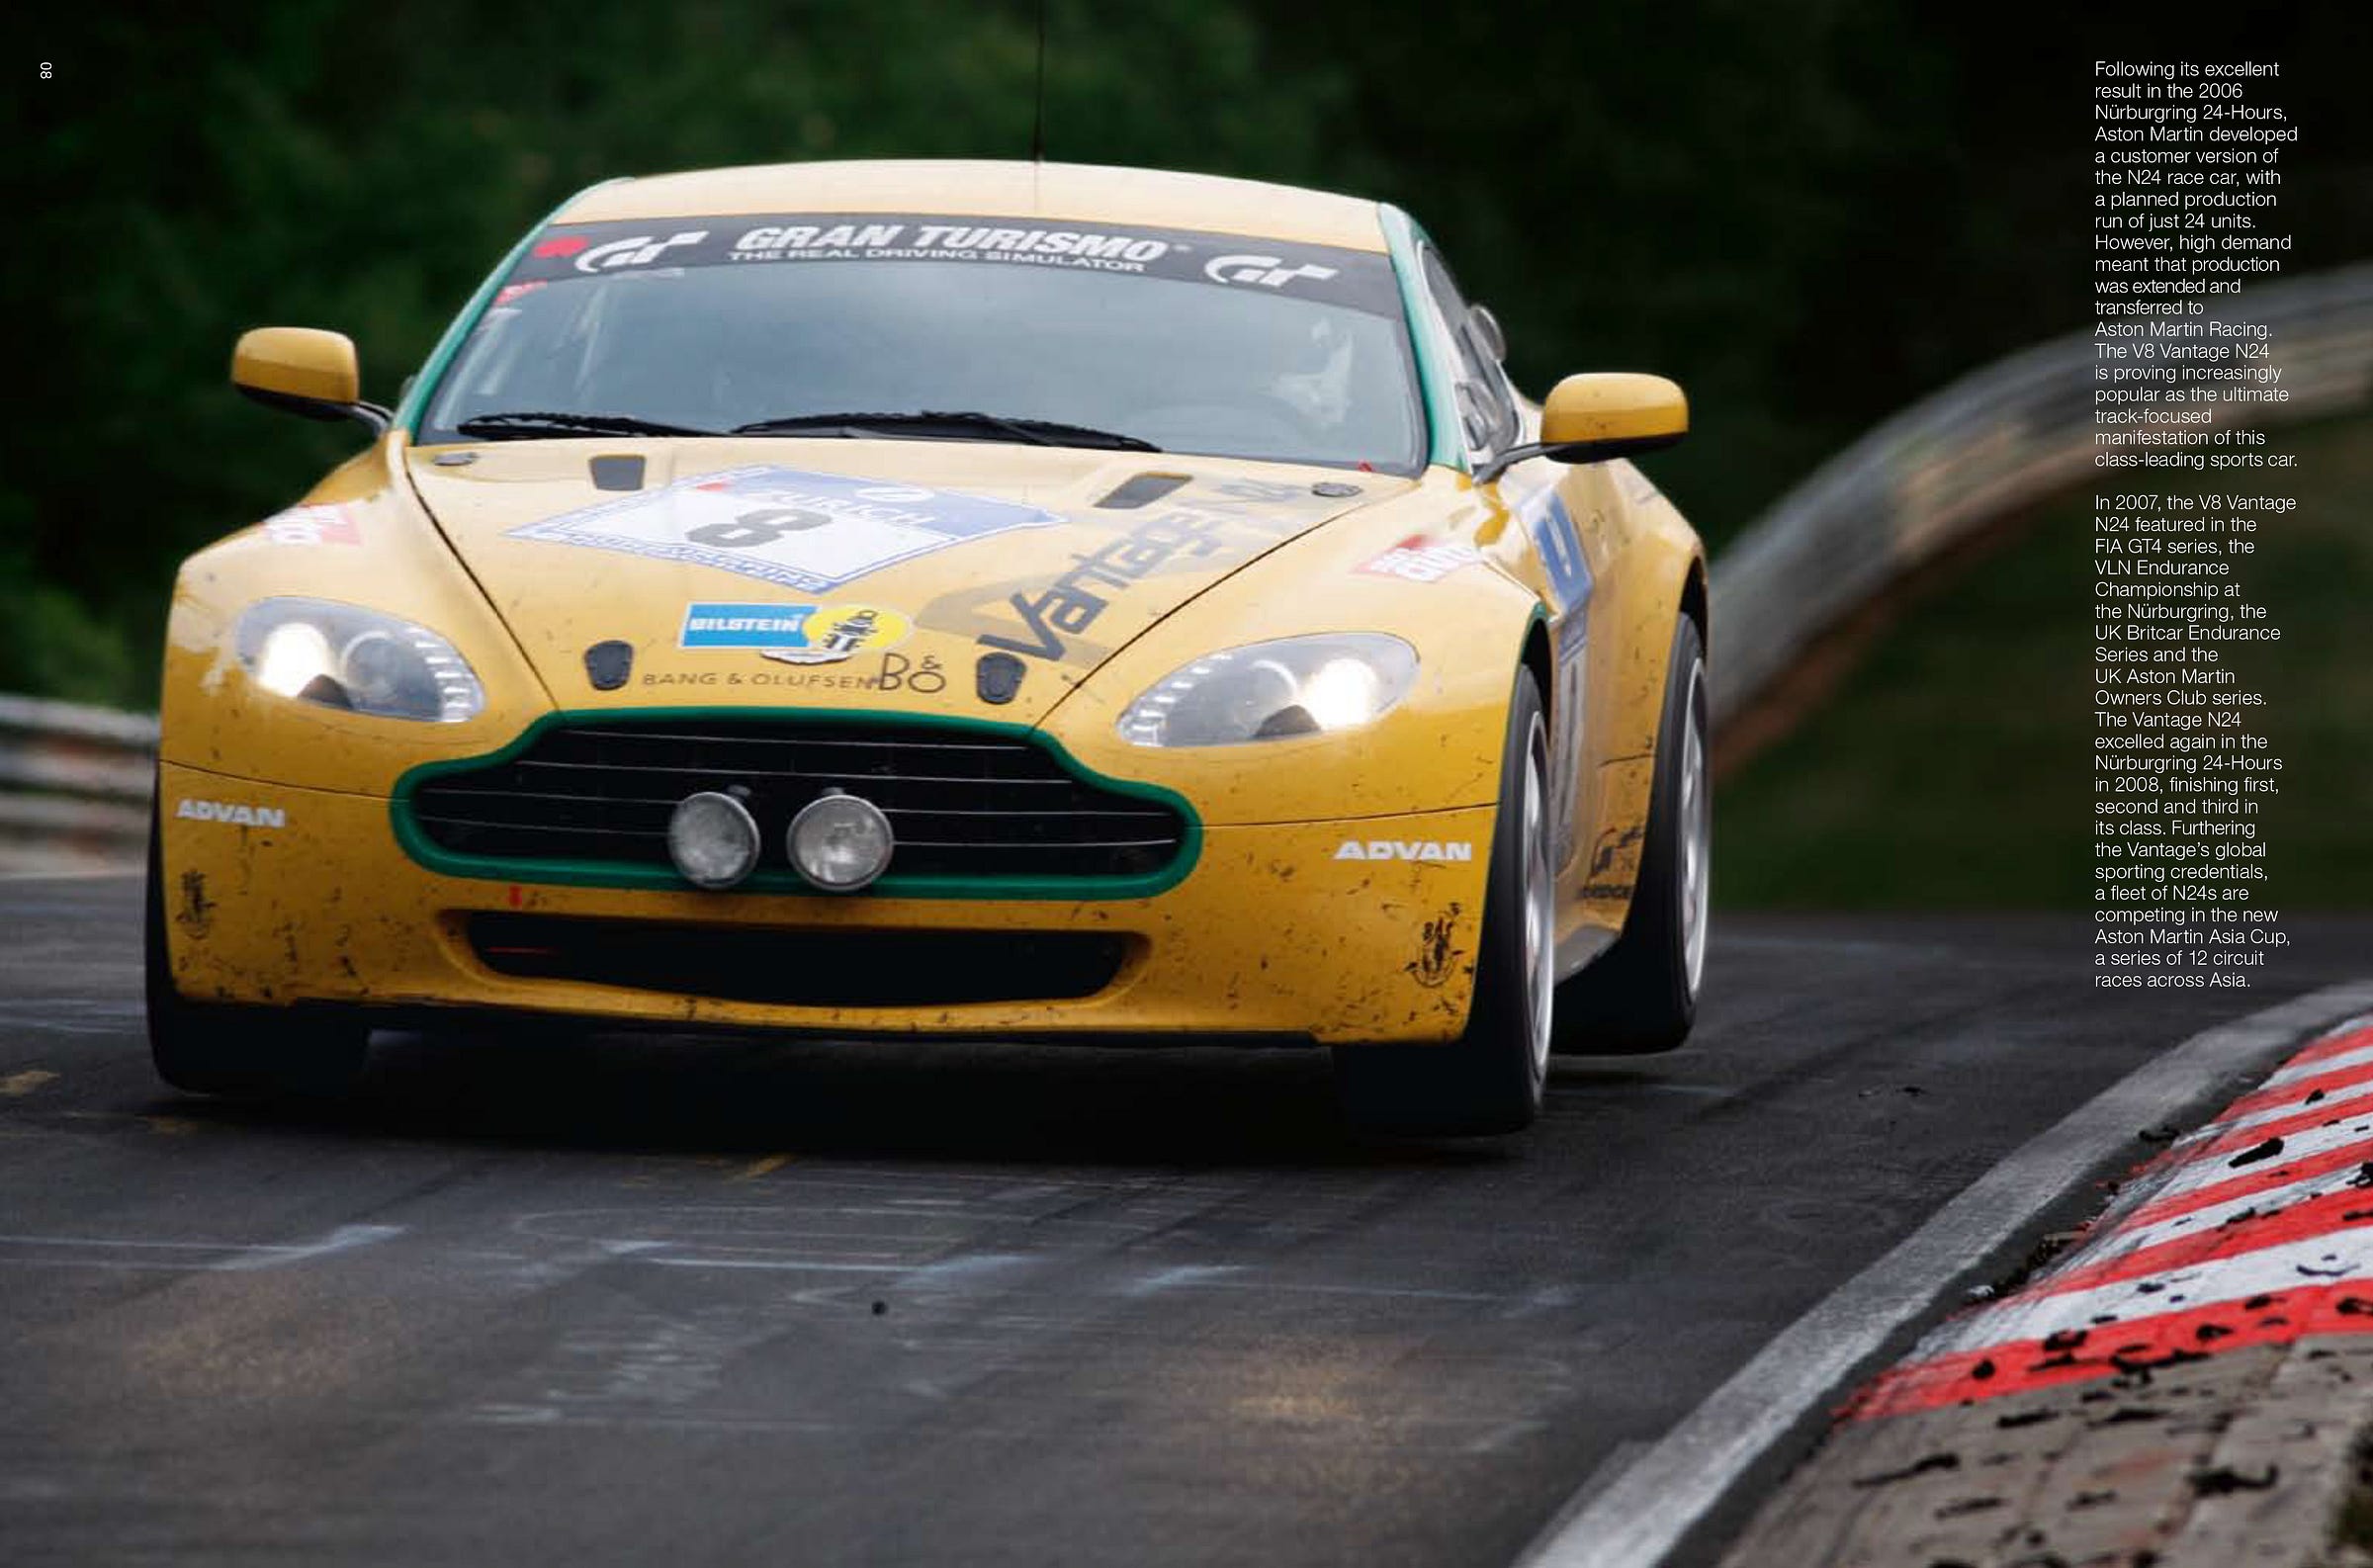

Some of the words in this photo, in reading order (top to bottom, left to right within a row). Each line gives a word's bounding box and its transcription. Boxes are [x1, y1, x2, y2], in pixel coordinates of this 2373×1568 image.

[736, 224, 904, 251] GRAN
[914, 225, 1170, 262] TURISMO
[727, 251, 782, 261] THE
[787, 248, 860, 259] REAL
[865, 248, 978, 260] DRIVING
[986, 249, 1145, 272] SIMULATOR
[684, 508, 834, 548] 8
[689, 616, 800, 633] BILSTEIN
[643, 672, 716, 687] BANG
[727, 672, 743, 686] &
[750, 672, 879, 690] OLUFSEN
[176, 798, 286, 828] ADVAN
[1333, 839, 1472, 861] ADVAN
